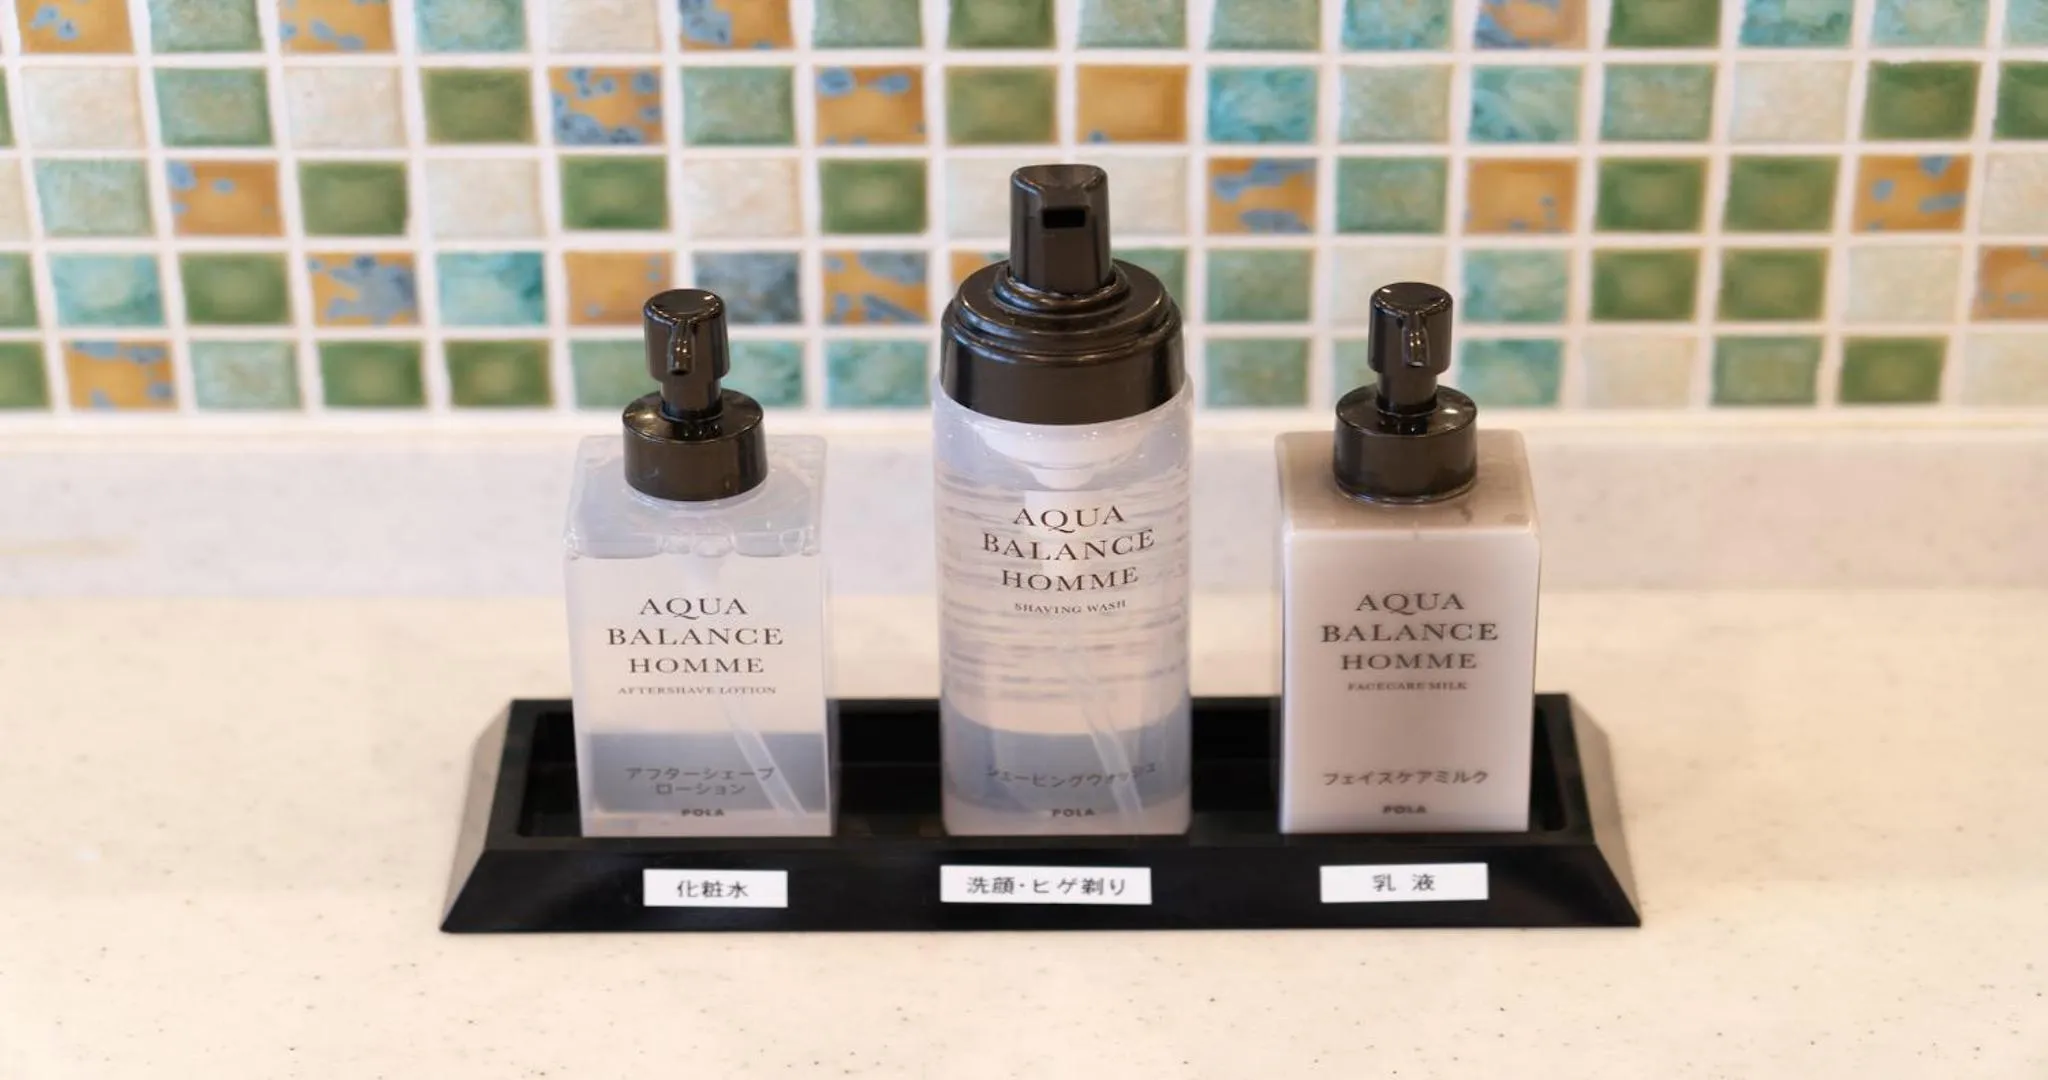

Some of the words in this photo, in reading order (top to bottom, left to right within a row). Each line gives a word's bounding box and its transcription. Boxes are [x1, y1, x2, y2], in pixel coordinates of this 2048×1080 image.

[1012, 504, 1125, 534] AQUA
[982, 528, 1156, 562] BALANCE
[1001, 566, 1139, 592] HOMME
[639, 598, 748, 621] AQUA
[1015, 602, 1082, 614] SHAVING
[1087, 599, 1126, 612] WASH
[1355, 593, 1465, 615] AQUA
[607, 627, 784, 647] BALANCE
[1321, 623, 1498, 643] BALANCE
[628, 657, 765, 675] HOMME
[1340, 653, 1478, 671] HOMME
[618, 686, 716, 695] AFTERSHAVE
[719, 686, 777, 695] LOTION
[1323, 770, 1489, 786] フェイスケアミルク
[655, 783, 745, 796] ローション
[681, 807, 725, 817] POLA
[1052, 808, 1097, 818] POLA
[1382, 805, 1428, 814] POLA
[676, 880, 749, 900] 化粧水
